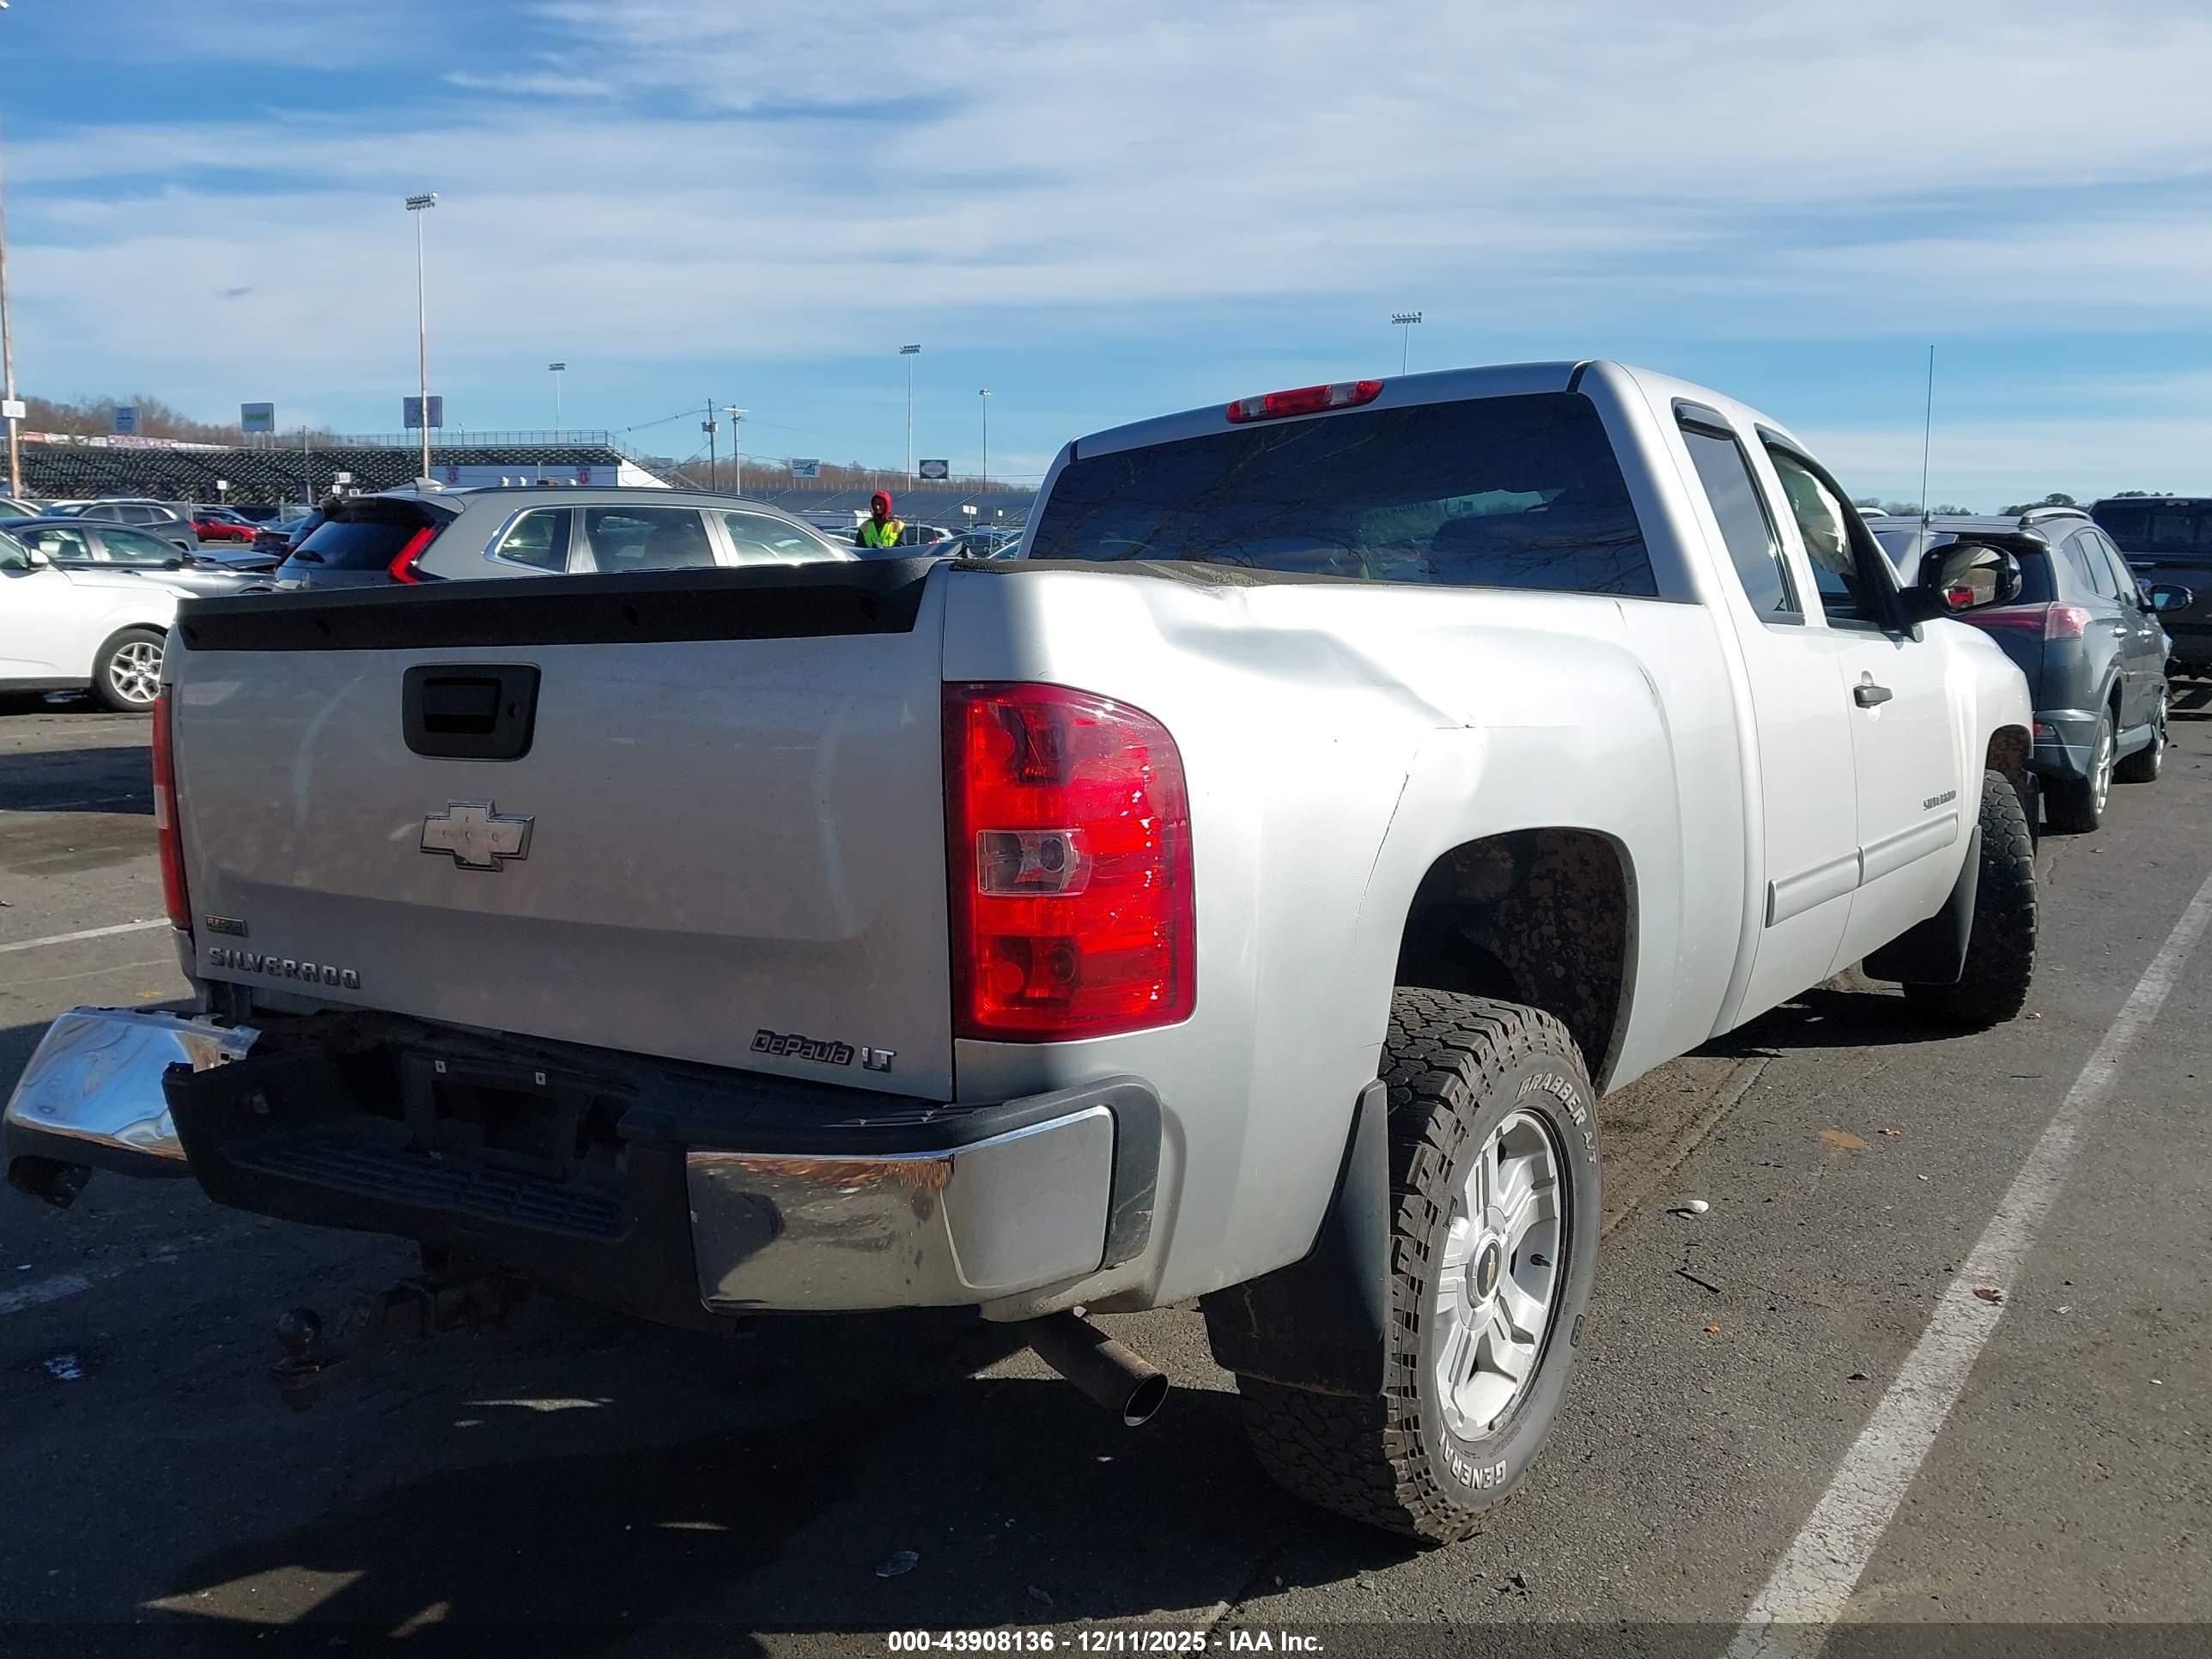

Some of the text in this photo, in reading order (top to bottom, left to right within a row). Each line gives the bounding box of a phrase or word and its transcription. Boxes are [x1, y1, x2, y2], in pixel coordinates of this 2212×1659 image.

[208, 946, 361, 989] SILVERADO
[750, 1029, 854, 1066] DePaula
[861, 1046, 896, 1073] LT
[1516, 1073, 1587, 1127] GRABBER
[1437, 1419, 1507, 1490] GENERAL
